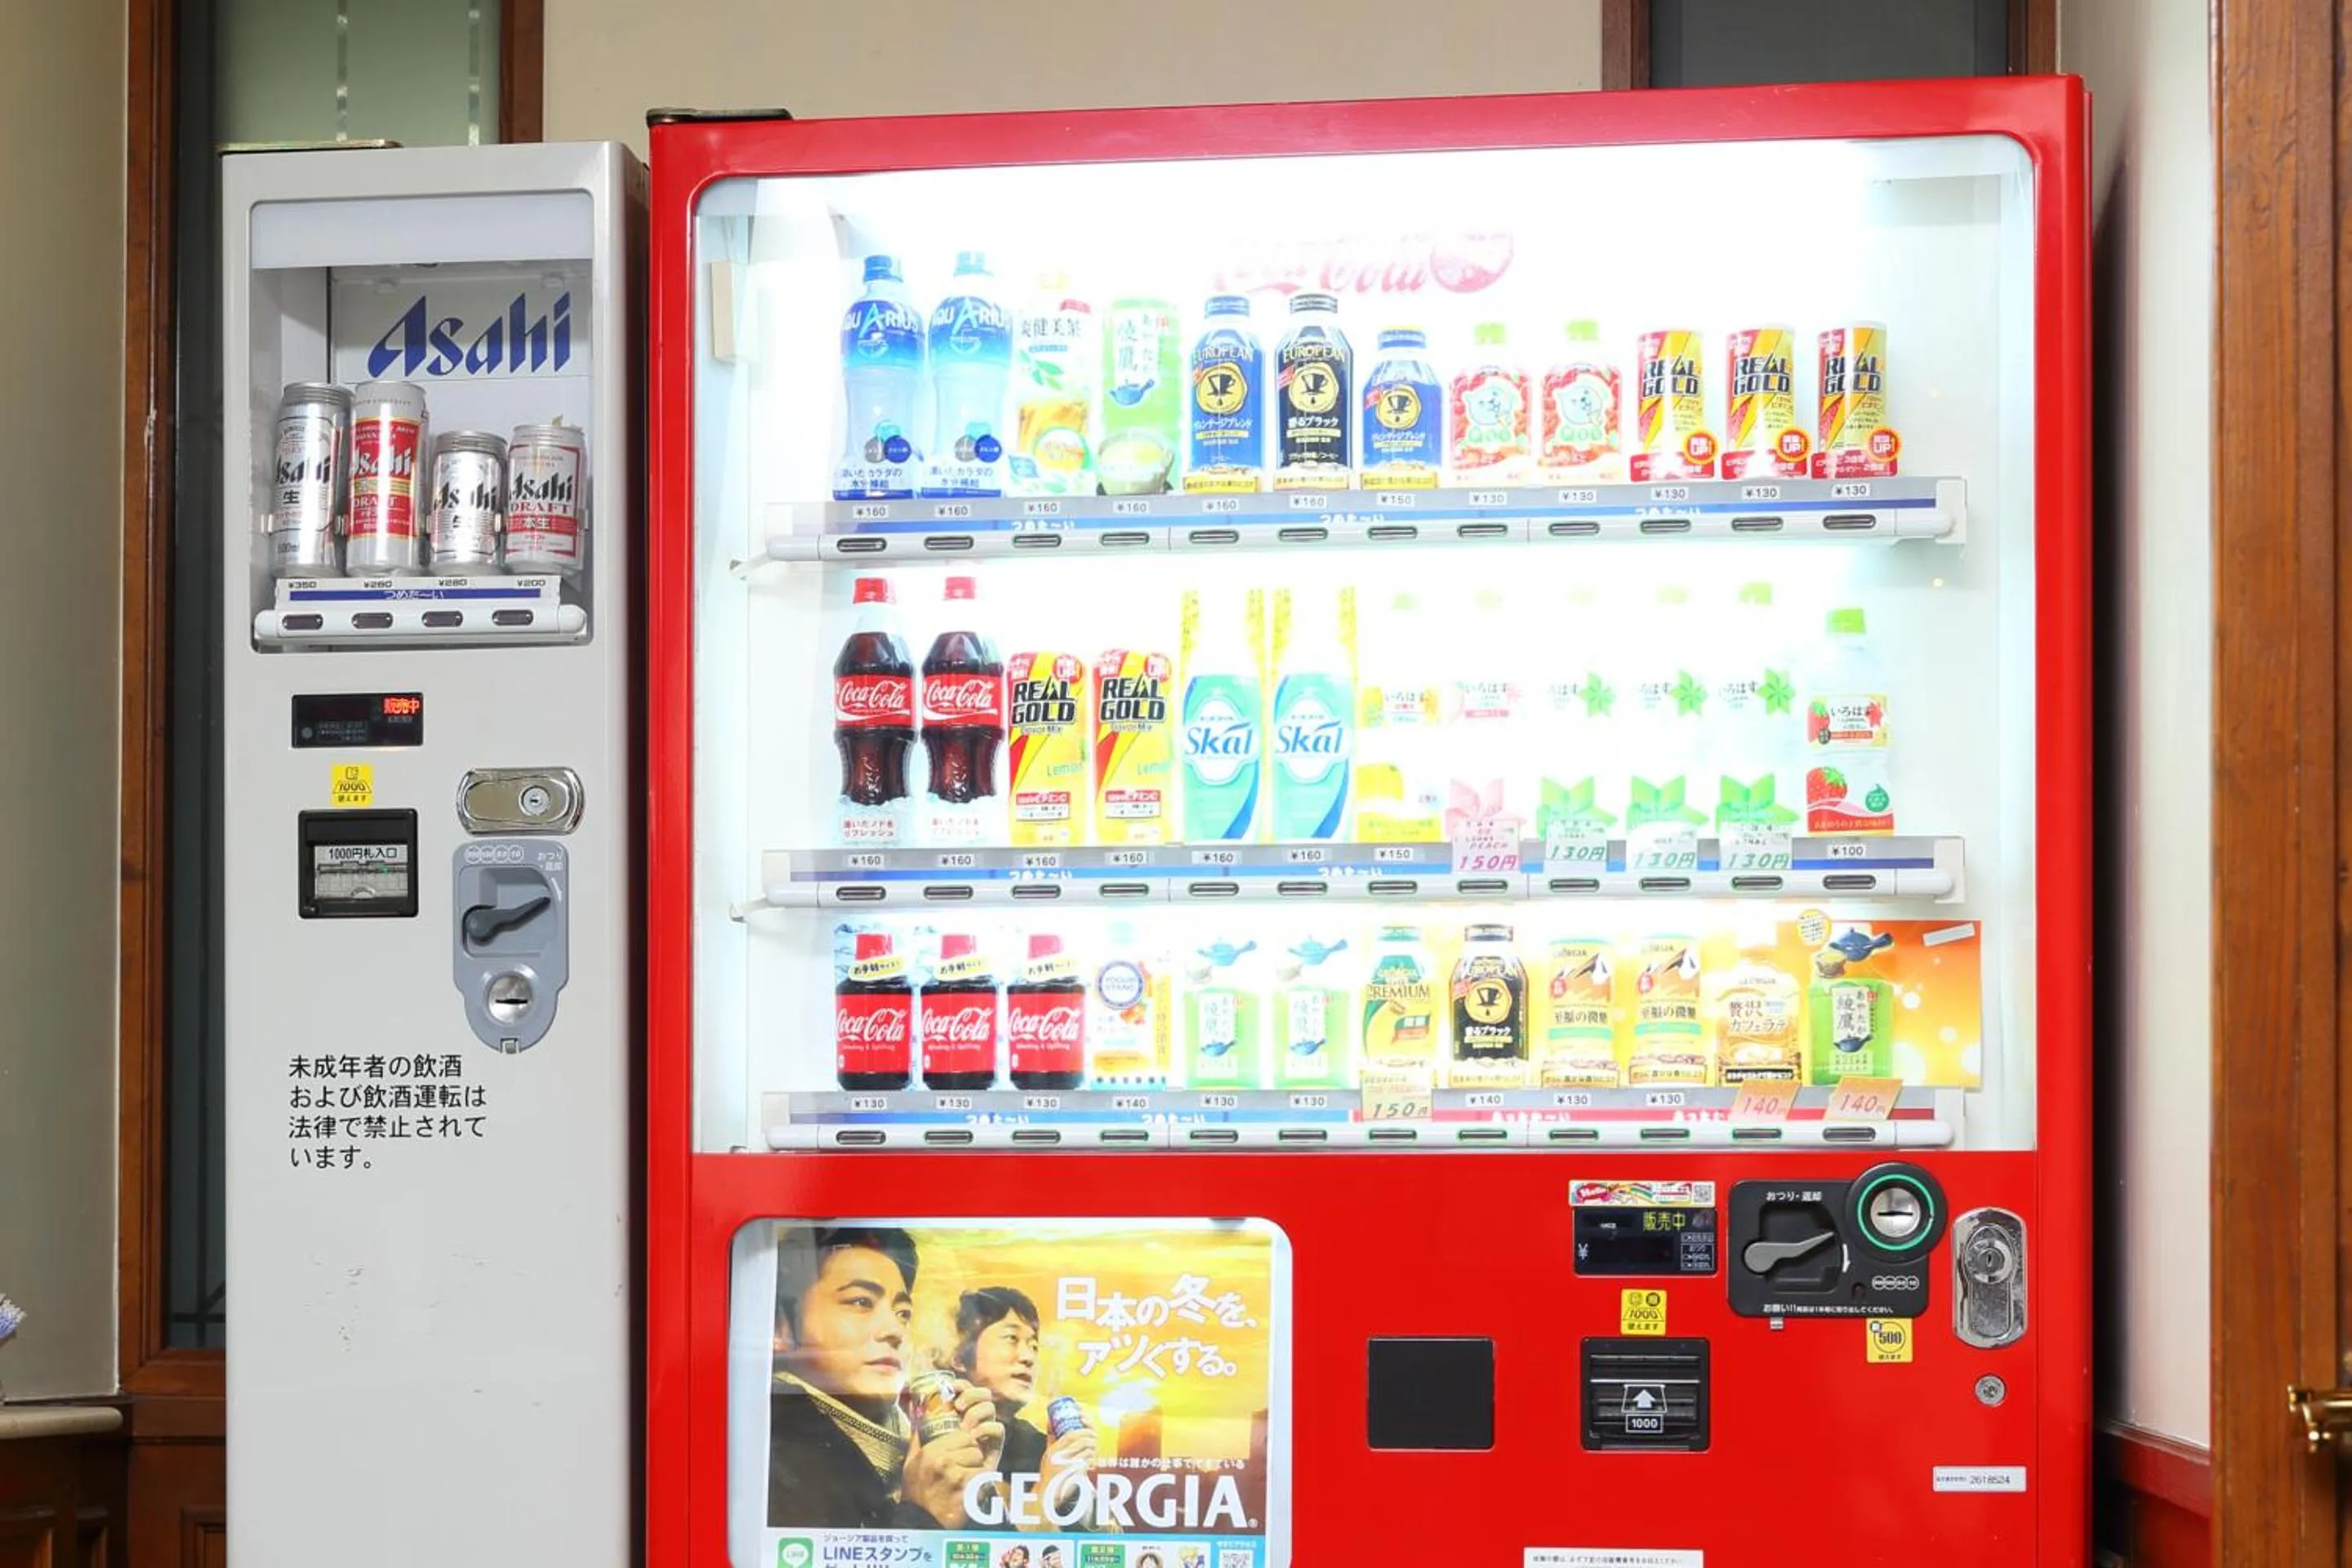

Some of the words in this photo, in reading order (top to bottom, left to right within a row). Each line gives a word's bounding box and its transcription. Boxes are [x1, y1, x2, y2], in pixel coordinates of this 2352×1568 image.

[368, 292, 570, 377] Asahi
[1735, 352, 1787, 377] REAL
[1733, 375, 1790, 396] GOLD
[510, 470, 573, 502] Asahi
[353, 497, 399, 507] DRAT
[510, 501, 571, 513] DRAFT
[839, 679, 908, 709] Coca-Cola
[926, 679, 994, 709] Coca-Cola
[1013, 675, 1076, 703] REAL
[1102, 673, 1164, 699] REAL
[1011, 701, 1076, 725] GOLD
[1100, 698, 1166, 723] GOLD
[328, 847, 398, 858] 1000円札入口
[851, 855, 881, 866] ¥160
[941, 855, 972, 866] ¥160
[1026, 856, 1056, 866] ¥160
[1114, 853, 1143, 862] ¥160
[1204, 852, 1234, 862] ¥160
[1291, 850, 1321, 861] ¥160
[1379, 849, 1410, 858] ¥150
[1459, 854, 1517, 870] 150円
[1552, 845, 1605, 861] 130円
[1634, 852, 1696, 868] 130円
[1728, 853, 1790, 869] 130円
[1832, 846, 1864, 856] ¥100
[836, 1007, 910, 1042] Coca-Cola
[922, 1006, 993, 1042] Coca-Cola
[1008, 1005, 1082, 1042] Coca-Cola
[289, 1054, 462, 1079] 未成年者の飲酒
[289, 1085, 488, 1109] および飲酒運転は
[288, 1115, 487, 1139] 法律で禁止されて
[291, 1145, 372, 1169] います。
[1643, 1211, 1686, 1232] 販売中
[1056, 1272, 1258, 1333] 日本の冬を、
[1878, 1331, 1902, 1345] 500
[1077, 1334, 1238, 1379] アツくする。
[1630, 1418, 1659, 1429] 1000
[963, 1468, 1249, 1529] GEORGIA
